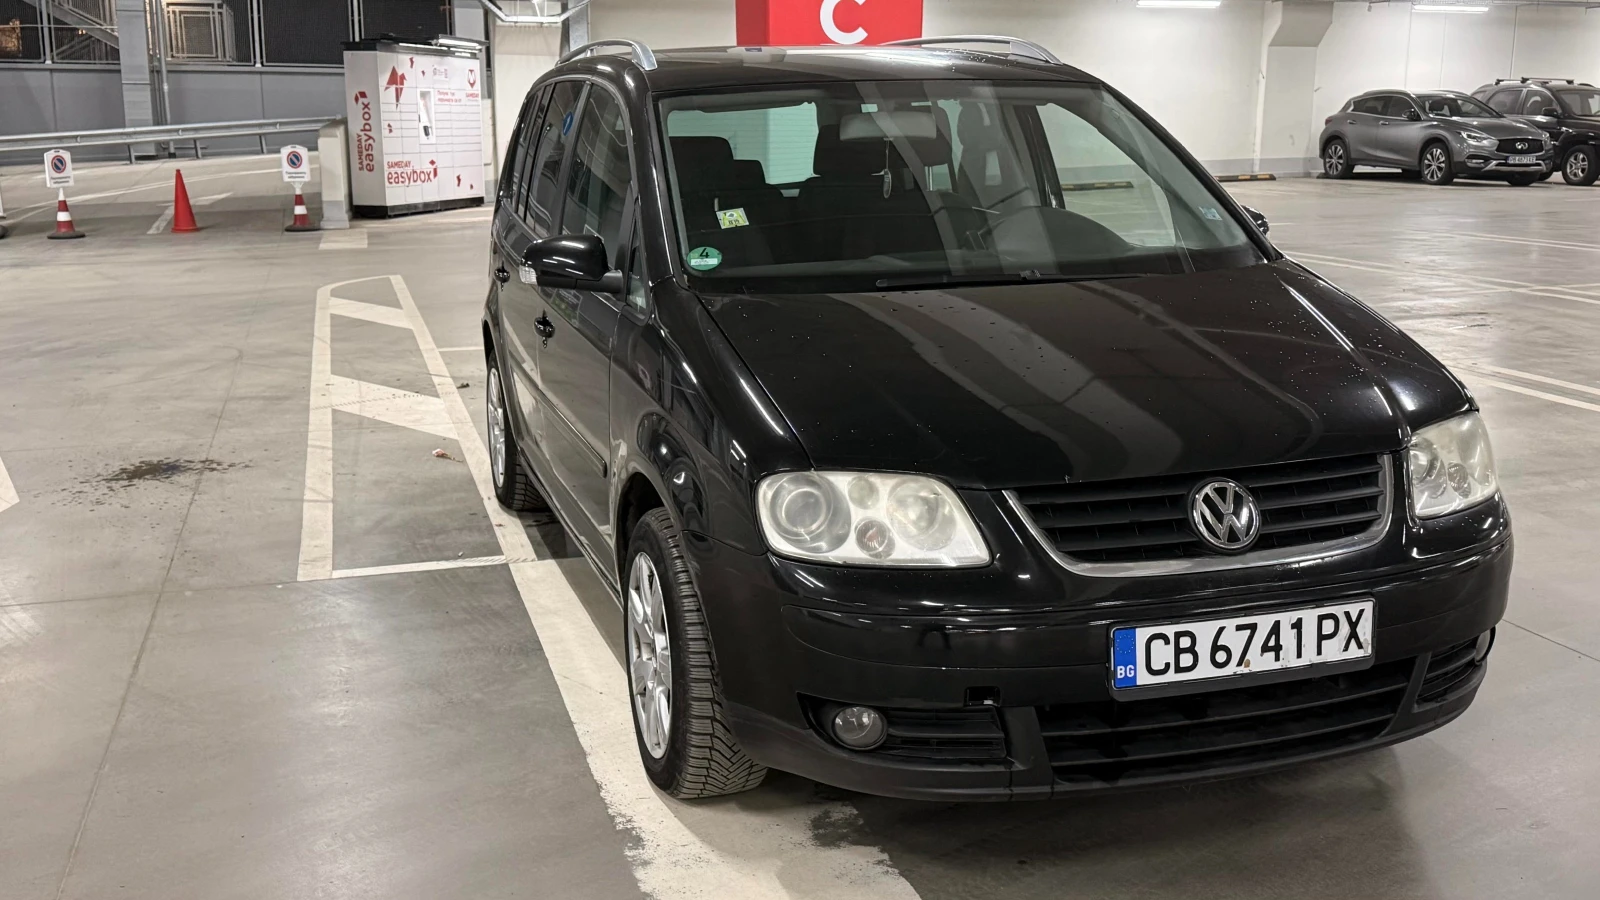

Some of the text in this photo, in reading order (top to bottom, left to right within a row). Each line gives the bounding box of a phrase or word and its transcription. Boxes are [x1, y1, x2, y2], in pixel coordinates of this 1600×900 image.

[819, 0, 868, 45] C
[360, 101, 375, 173] easybox
[356, 133, 364, 172] SAMEDAY
[386, 160, 411, 169] SAMEDAY
[387, 166, 432, 187] easybox
[699, 247, 710, 259] 4
[1144, 608, 1366, 676] CB 6741 PX
[1116, 664, 1135, 679] BG
